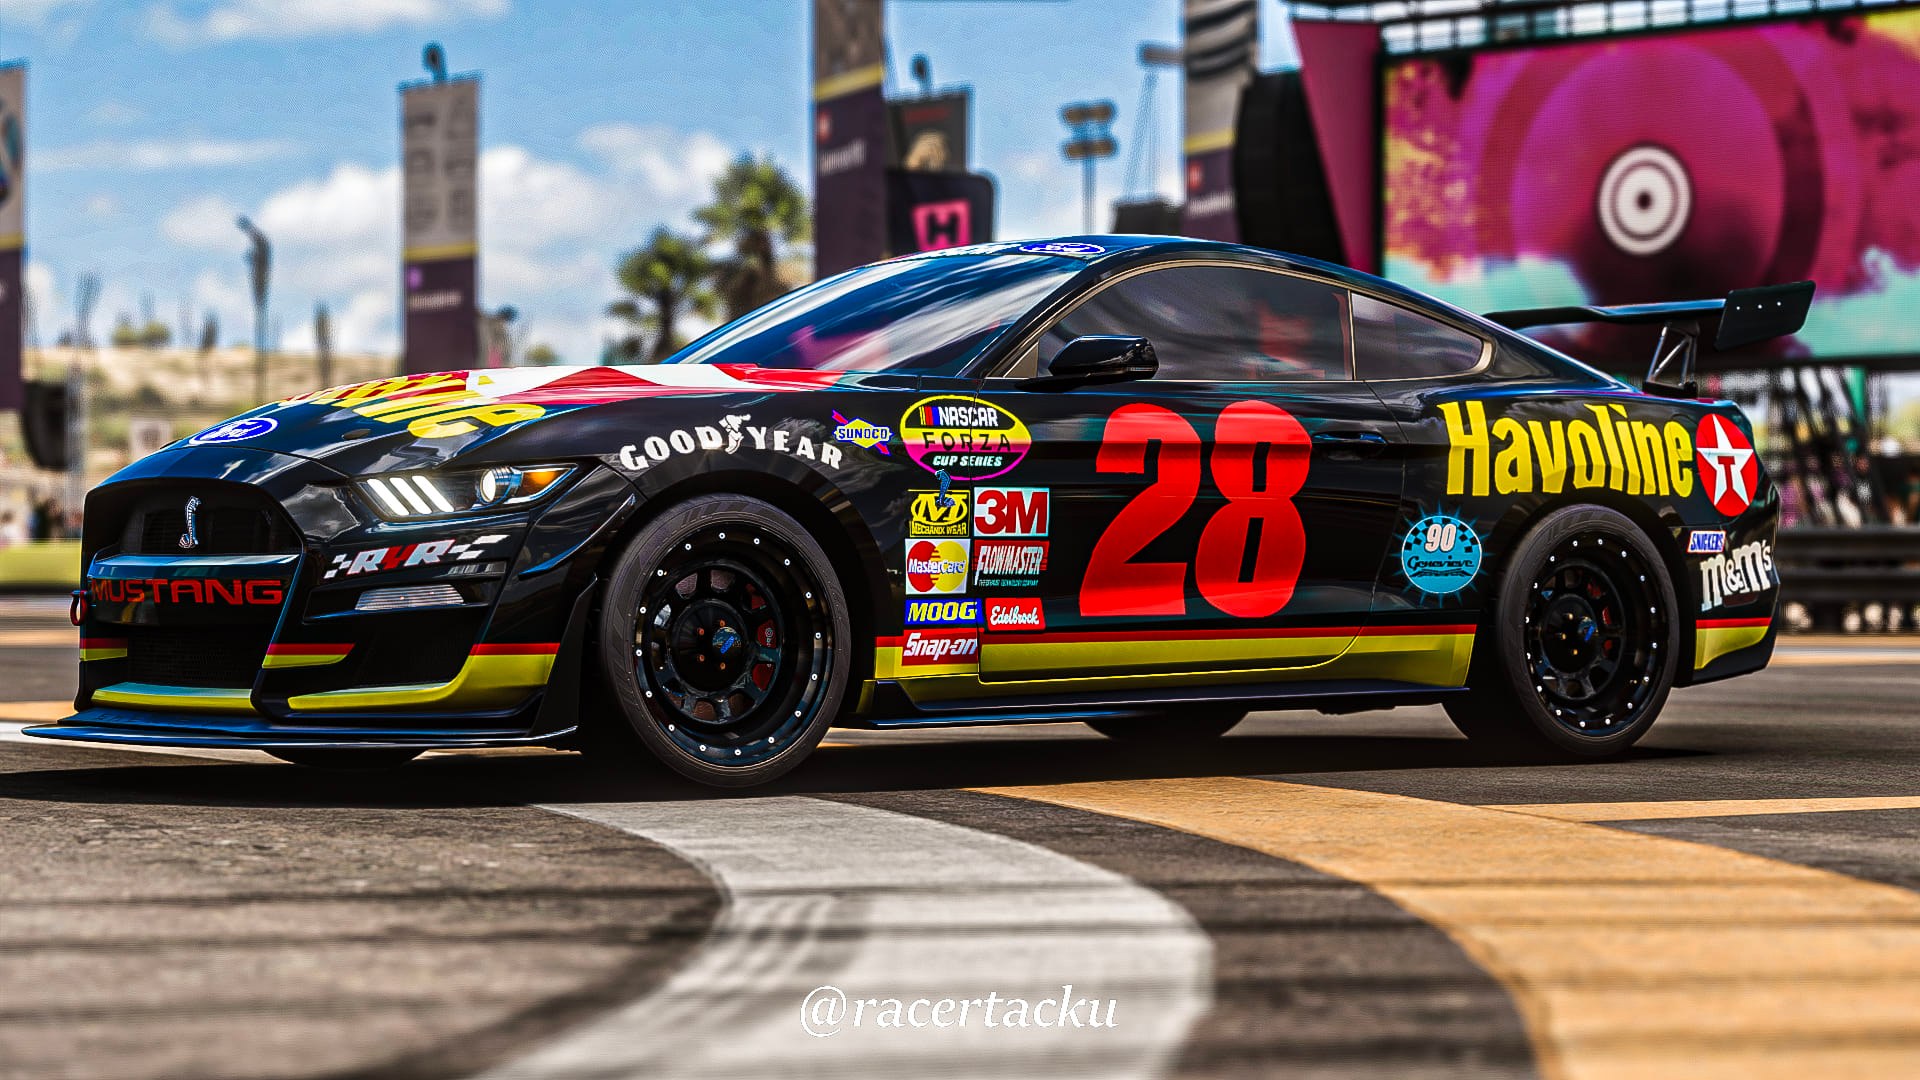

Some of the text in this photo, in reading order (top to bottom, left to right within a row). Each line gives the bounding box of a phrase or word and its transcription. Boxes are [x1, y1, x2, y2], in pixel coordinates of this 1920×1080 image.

[938, 406, 999, 427] NASCAR
[838, 426, 889, 441] SUNOCO
[922, 431, 1011, 451] FORZA
[1437, 400, 1694, 498] Havoline
[932, 455, 1003, 467] CUP SERIES
[974, 489, 1049, 535] 3M
[1080, 400, 1312, 618] 28
[1425, 523, 1457, 553] 90
[1690, 533, 1724, 551] SNICKERS
[974, 545, 1044, 586] FLOWMASTER
[91, 579, 283, 605] MUSTANG
[908, 602, 977, 622] MOOG
[990, 605, 1039, 625] Edelbrock
[903, 632, 977, 661] Snap-on
